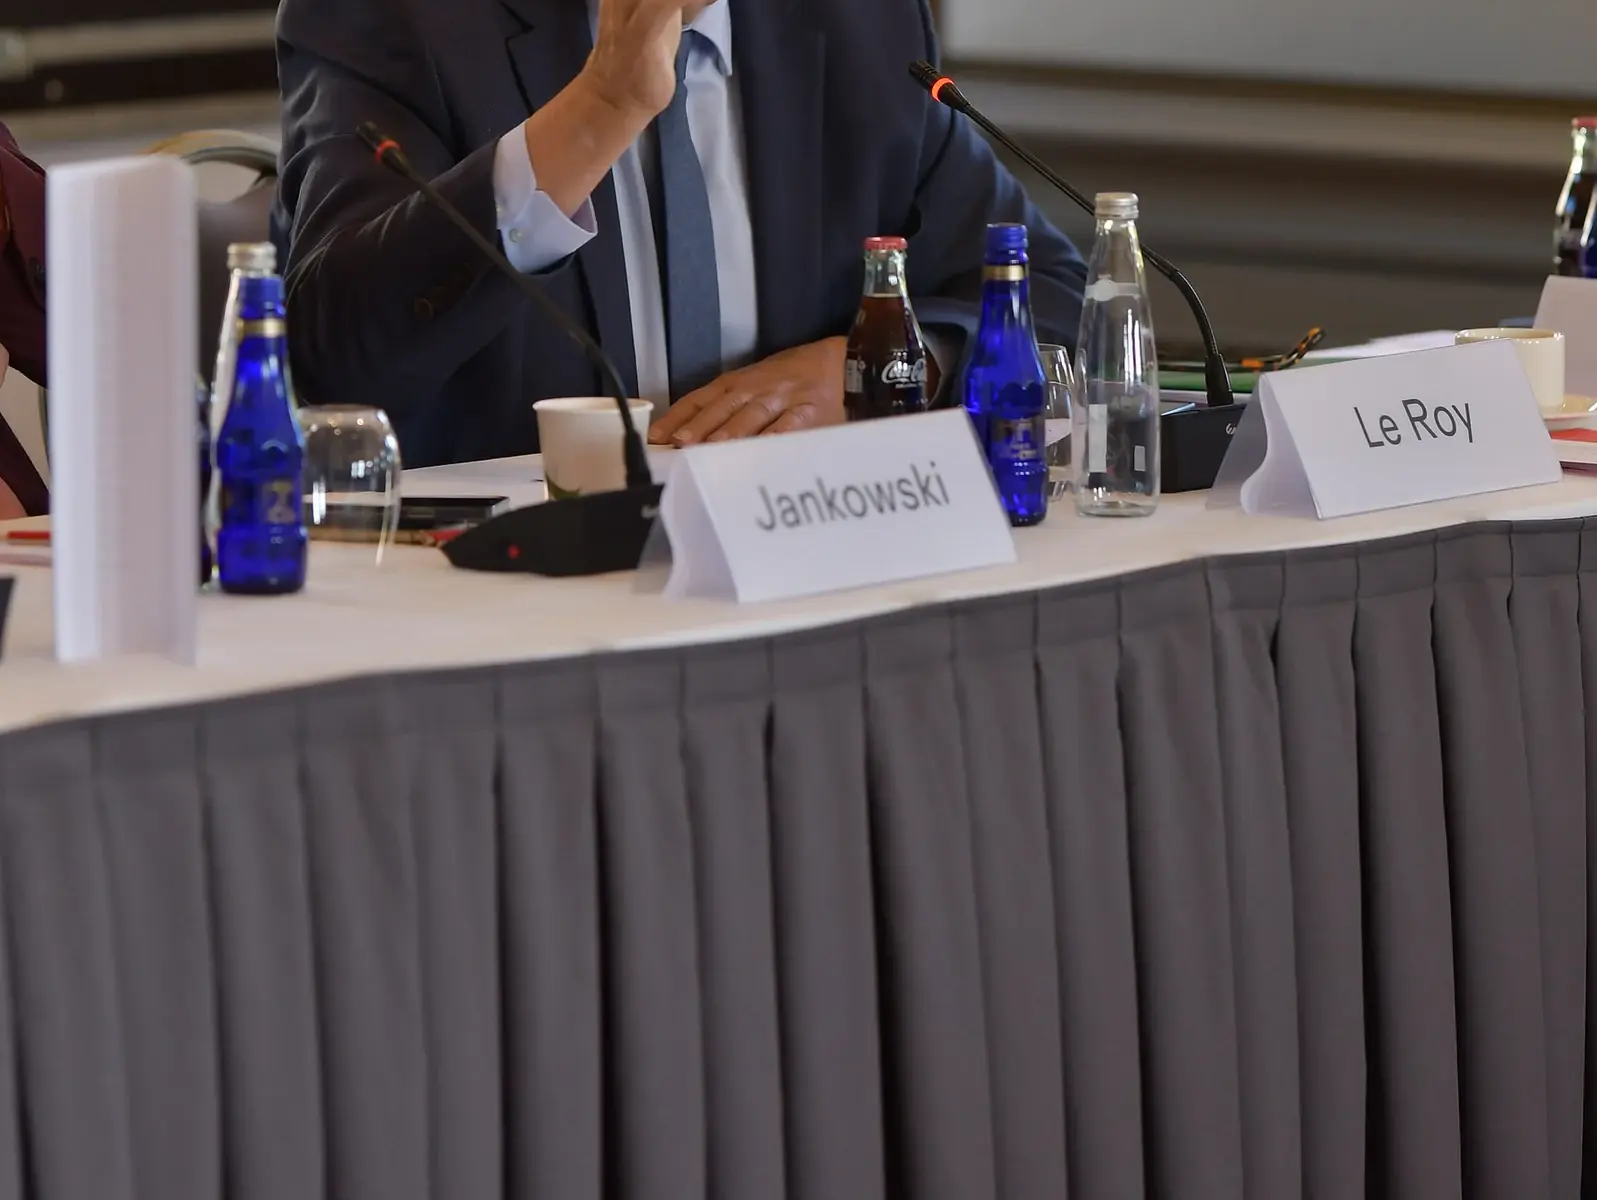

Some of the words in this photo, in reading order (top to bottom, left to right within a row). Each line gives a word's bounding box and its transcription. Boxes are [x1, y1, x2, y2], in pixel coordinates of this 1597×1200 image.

[1353, 406, 1402, 448] Le
[1401, 398, 1474, 443] Roy
[755, 460, 951, 532] Jankowski
